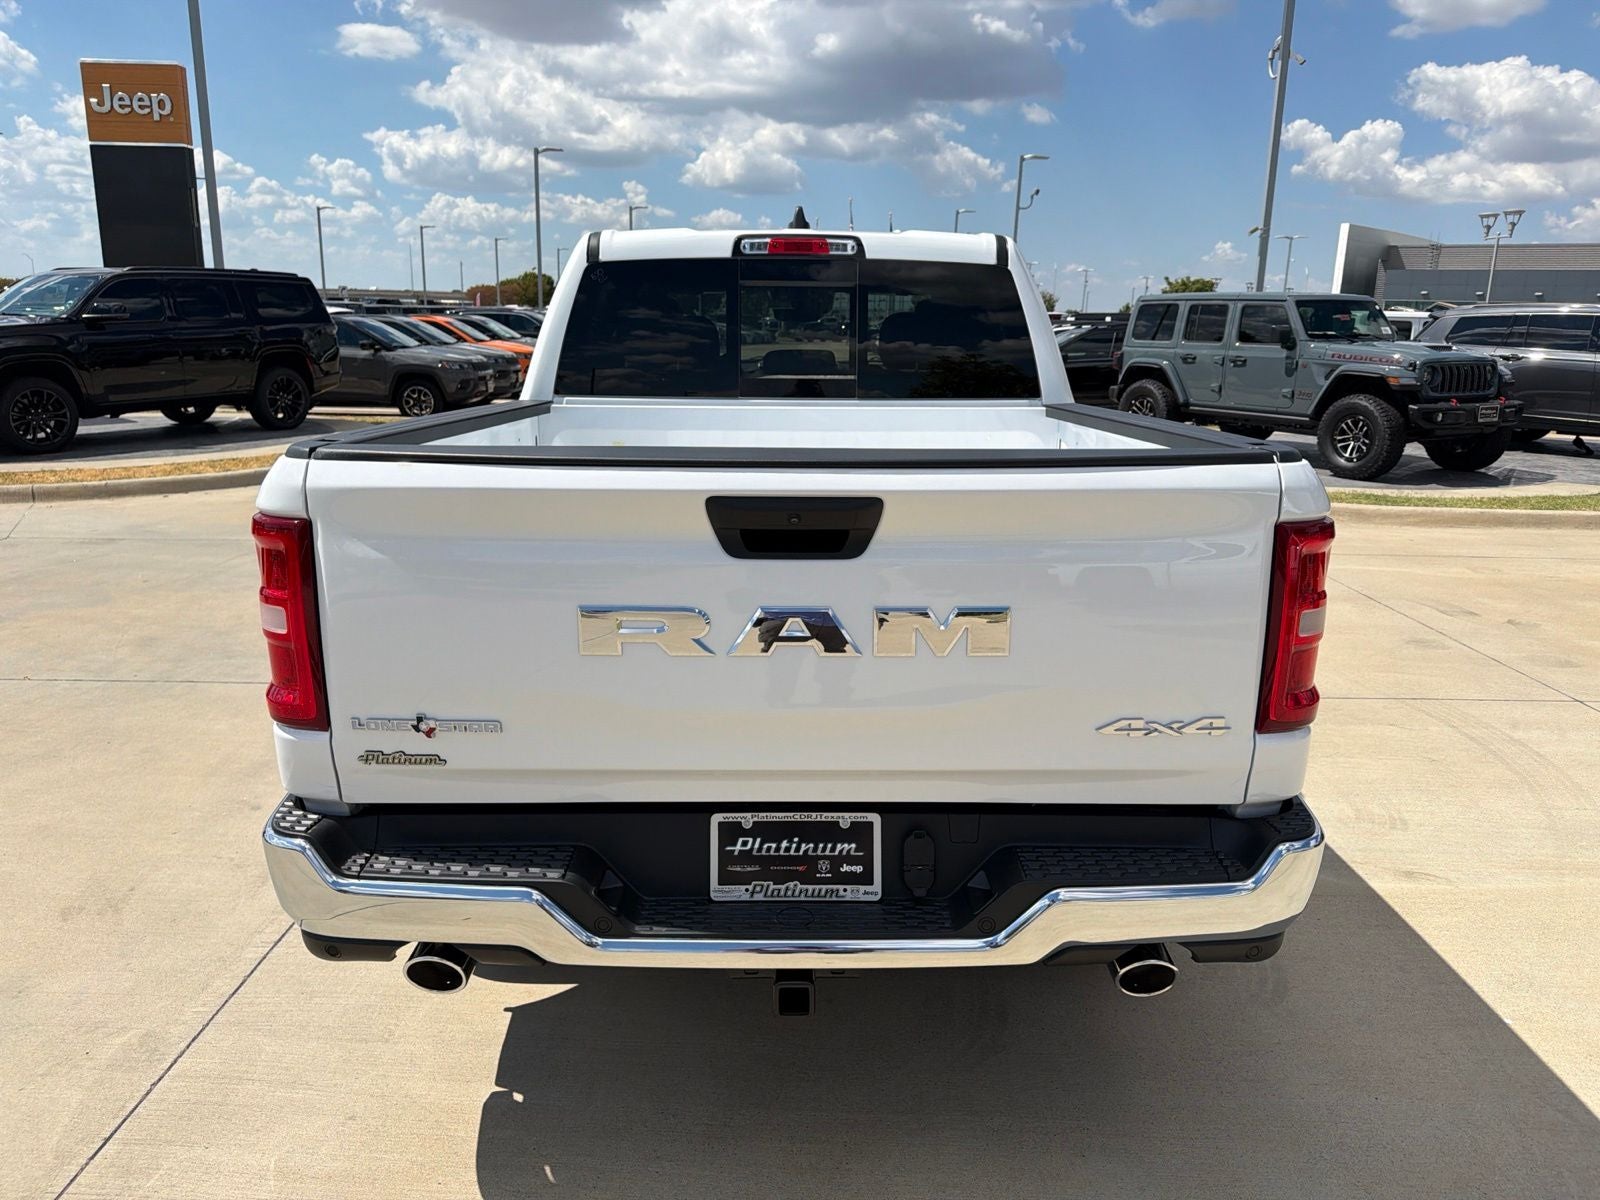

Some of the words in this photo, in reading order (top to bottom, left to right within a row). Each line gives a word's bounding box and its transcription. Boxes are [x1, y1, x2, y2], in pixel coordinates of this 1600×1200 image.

[89, 83, 172, 121] Jeep
[577, 605, 1011, 657] RAM
[351, 717, 411, 731] LONE
[437, 719, 503, 733] STAR
[1095, 716, 1232, 737] 4x4
[358, 750, 447, 766] Platinum
[722, 813, 869, 821] www.PlatinumCDRJTexas.com
[725, 837, 865, 856] Platinum
[840, 863, 864, 874] Jeep
[749, 881, 847, 899] Platinum
[862, 889, 879, 897] Jeep
